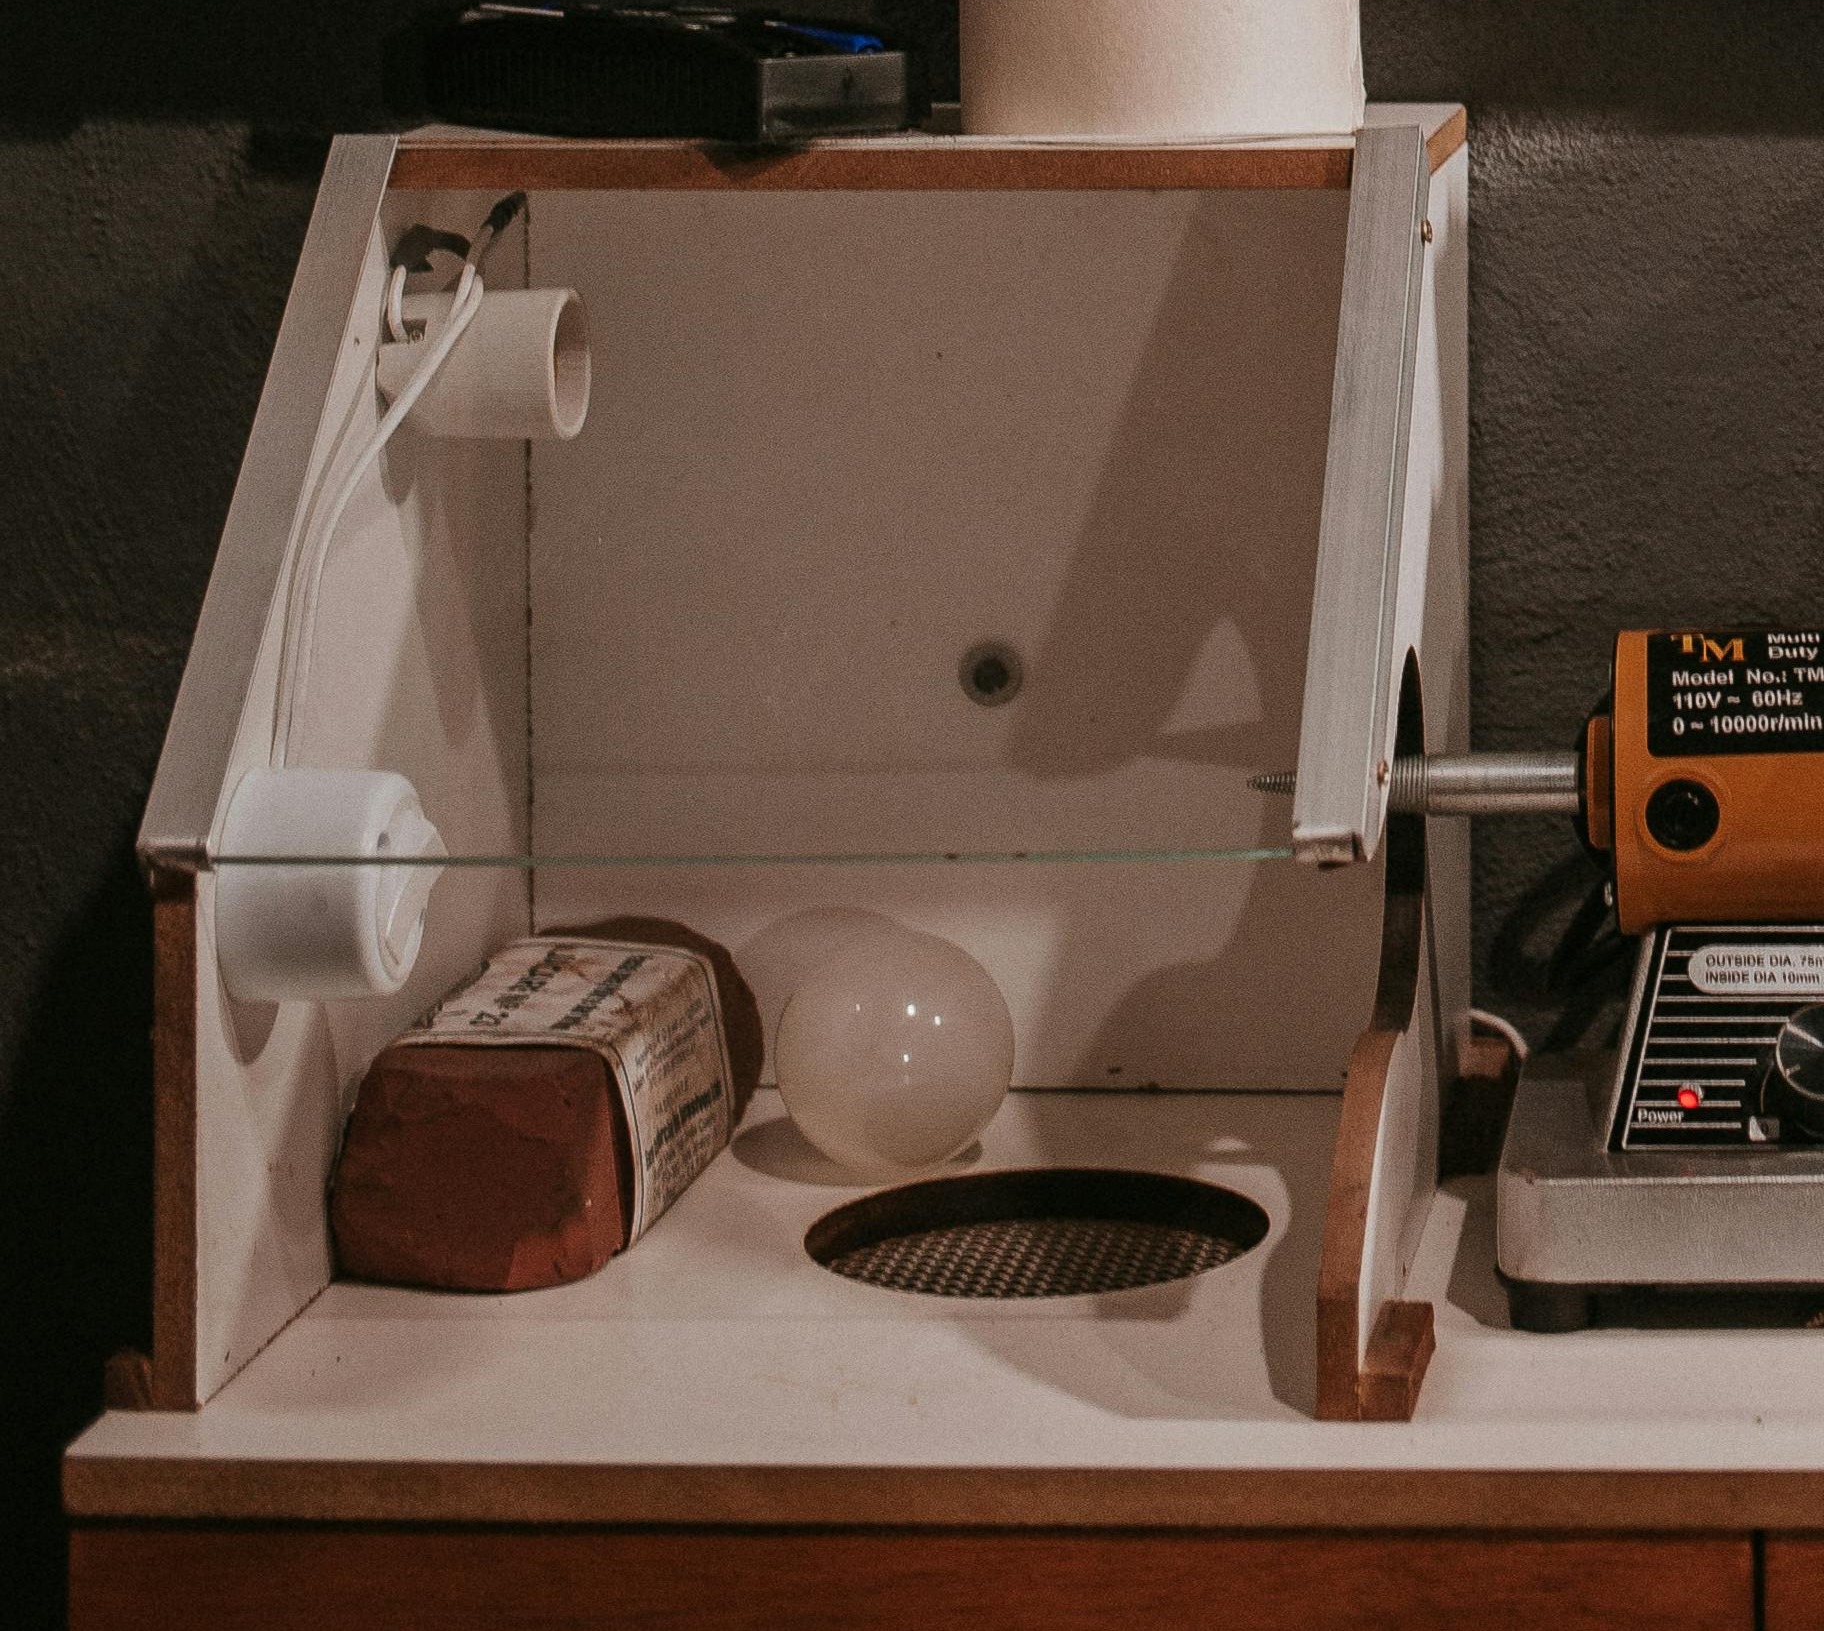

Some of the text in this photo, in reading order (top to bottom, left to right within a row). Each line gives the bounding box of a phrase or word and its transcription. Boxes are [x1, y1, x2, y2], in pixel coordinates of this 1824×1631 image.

[1669, 633, 1745, 663] TM
[1767, 646, 1818, 661] Duty
[1672, 669, 1734, 686] Model
[1673, 691, 1722, 710] 110V
[1752, 688, 1803, 708] 60Hz
[1710, 712, 1823, 734] 10000r/min
[1753, 971, 1777, 984] DIA
[1637, 1108, 1685, 1124] Power
